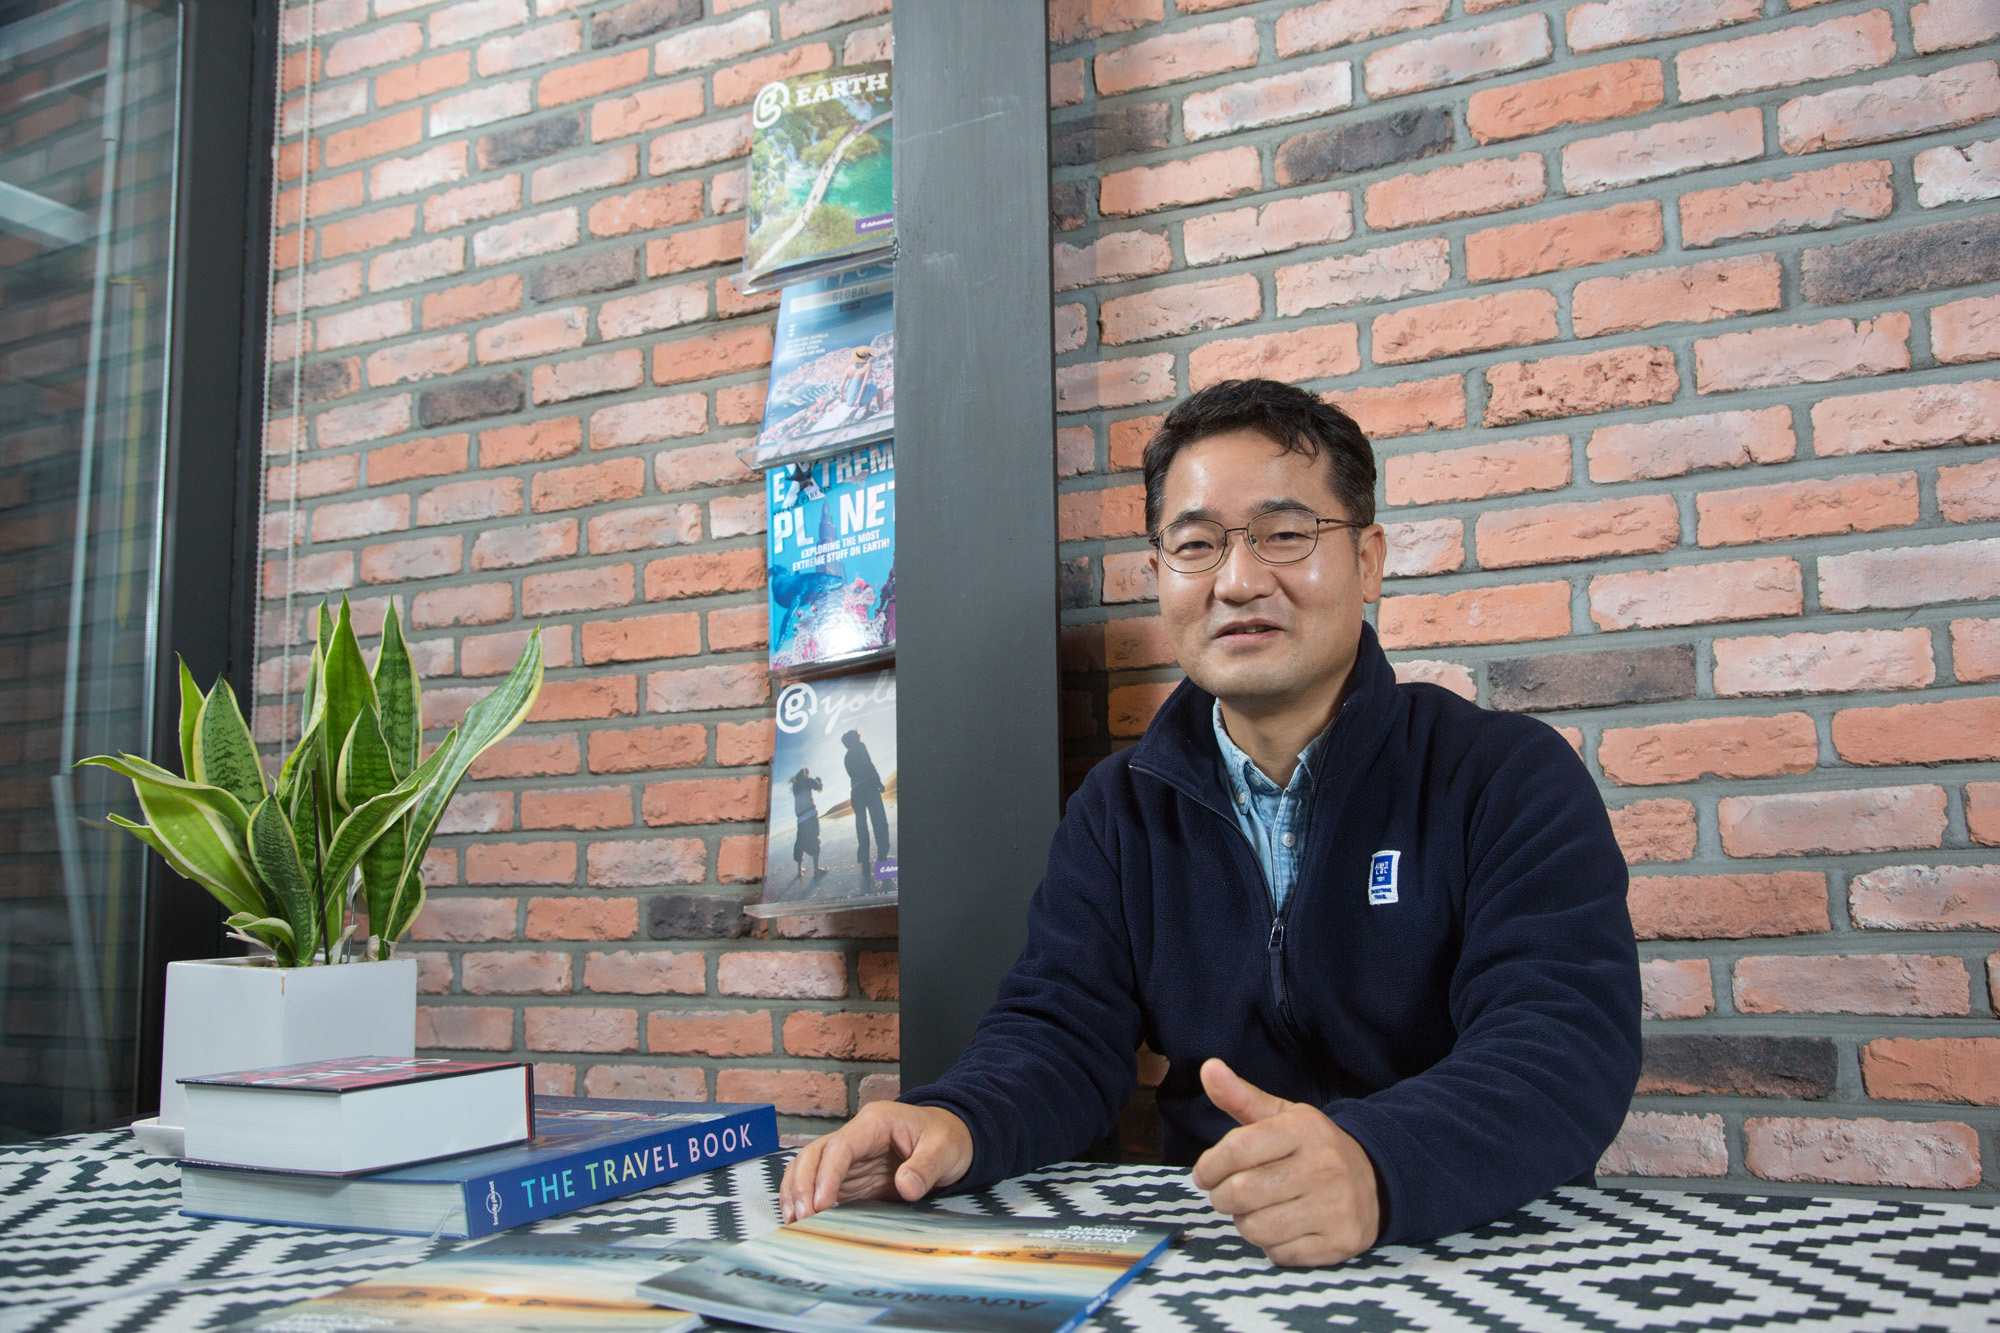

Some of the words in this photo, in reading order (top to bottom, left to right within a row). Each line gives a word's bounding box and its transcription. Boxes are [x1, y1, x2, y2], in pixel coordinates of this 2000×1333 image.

[796, 72, 889, 107] EARTH
[832, 285, 869, 302] GLOBAL
[793, 554, 825, 571] EXTREME
[827, 548, 848, 563] STUFF
[850, 545, 861, 556] ON
[863, 538, 890, 553] EARTH!
[801, 540, 840, 559] EXPLORING
[842, 536, 857, 548] THE
[858, 529, 880, 544] MOST
[251, 1058, 451, 1085] CITIES
[521, 1168, 575, 1208] THE
[585, 1144, 679, 1190] TRAVEL
[688, 1123, 753, 1163] BOOK
[723, 1267, 829, 1294] Travel
[851, 1288, 1050, 1310] Adventure
